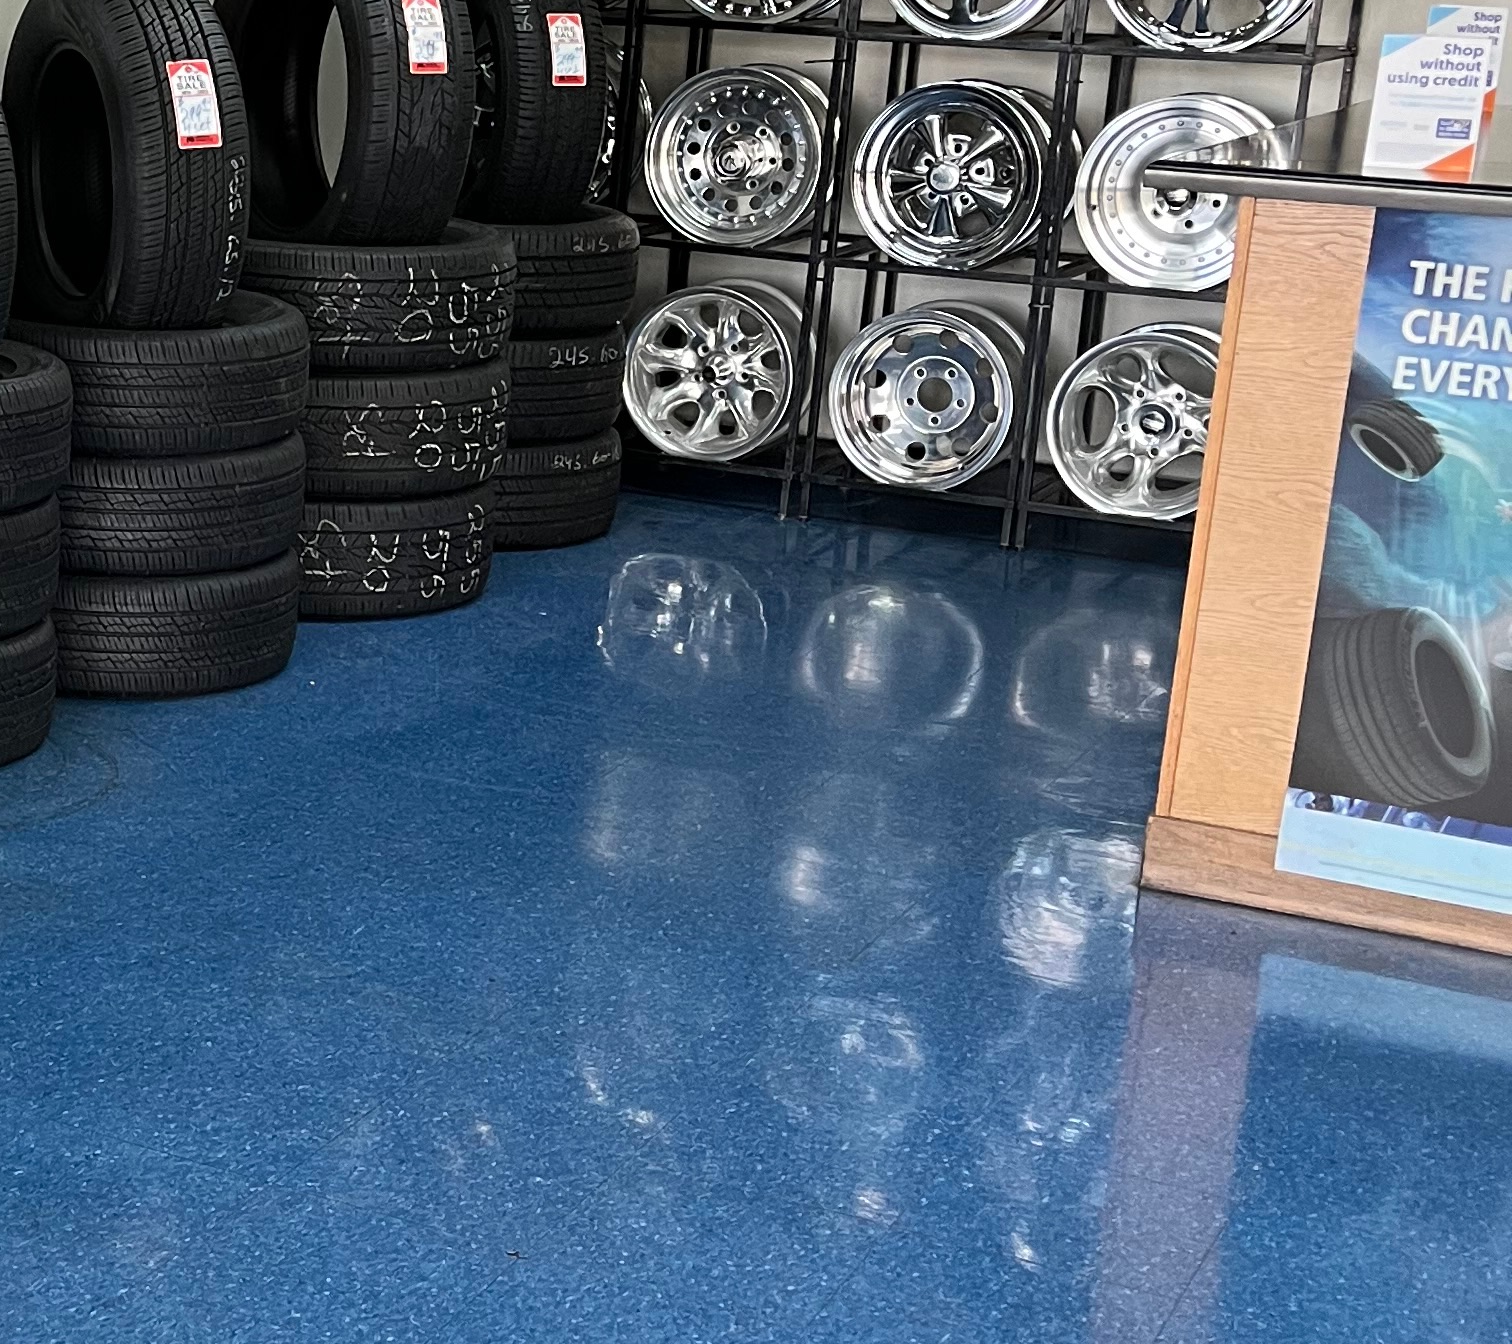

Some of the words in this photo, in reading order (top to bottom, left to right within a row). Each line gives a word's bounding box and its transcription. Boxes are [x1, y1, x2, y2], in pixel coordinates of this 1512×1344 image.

[1474, 11, 1503, 23] Shop
[1456, 23, 1501, 35] without
[1442, 43, 1485, 58] Shop
[1419, 58, 1482, 72] without
[176, 74, 204, 83] TIRE
[1387, 71, 1430, 87] using
[1432, 73, 1481, 88] credit
[176, 81, 207, 91] SALE
[1409, 259, 1491, 301] THE
